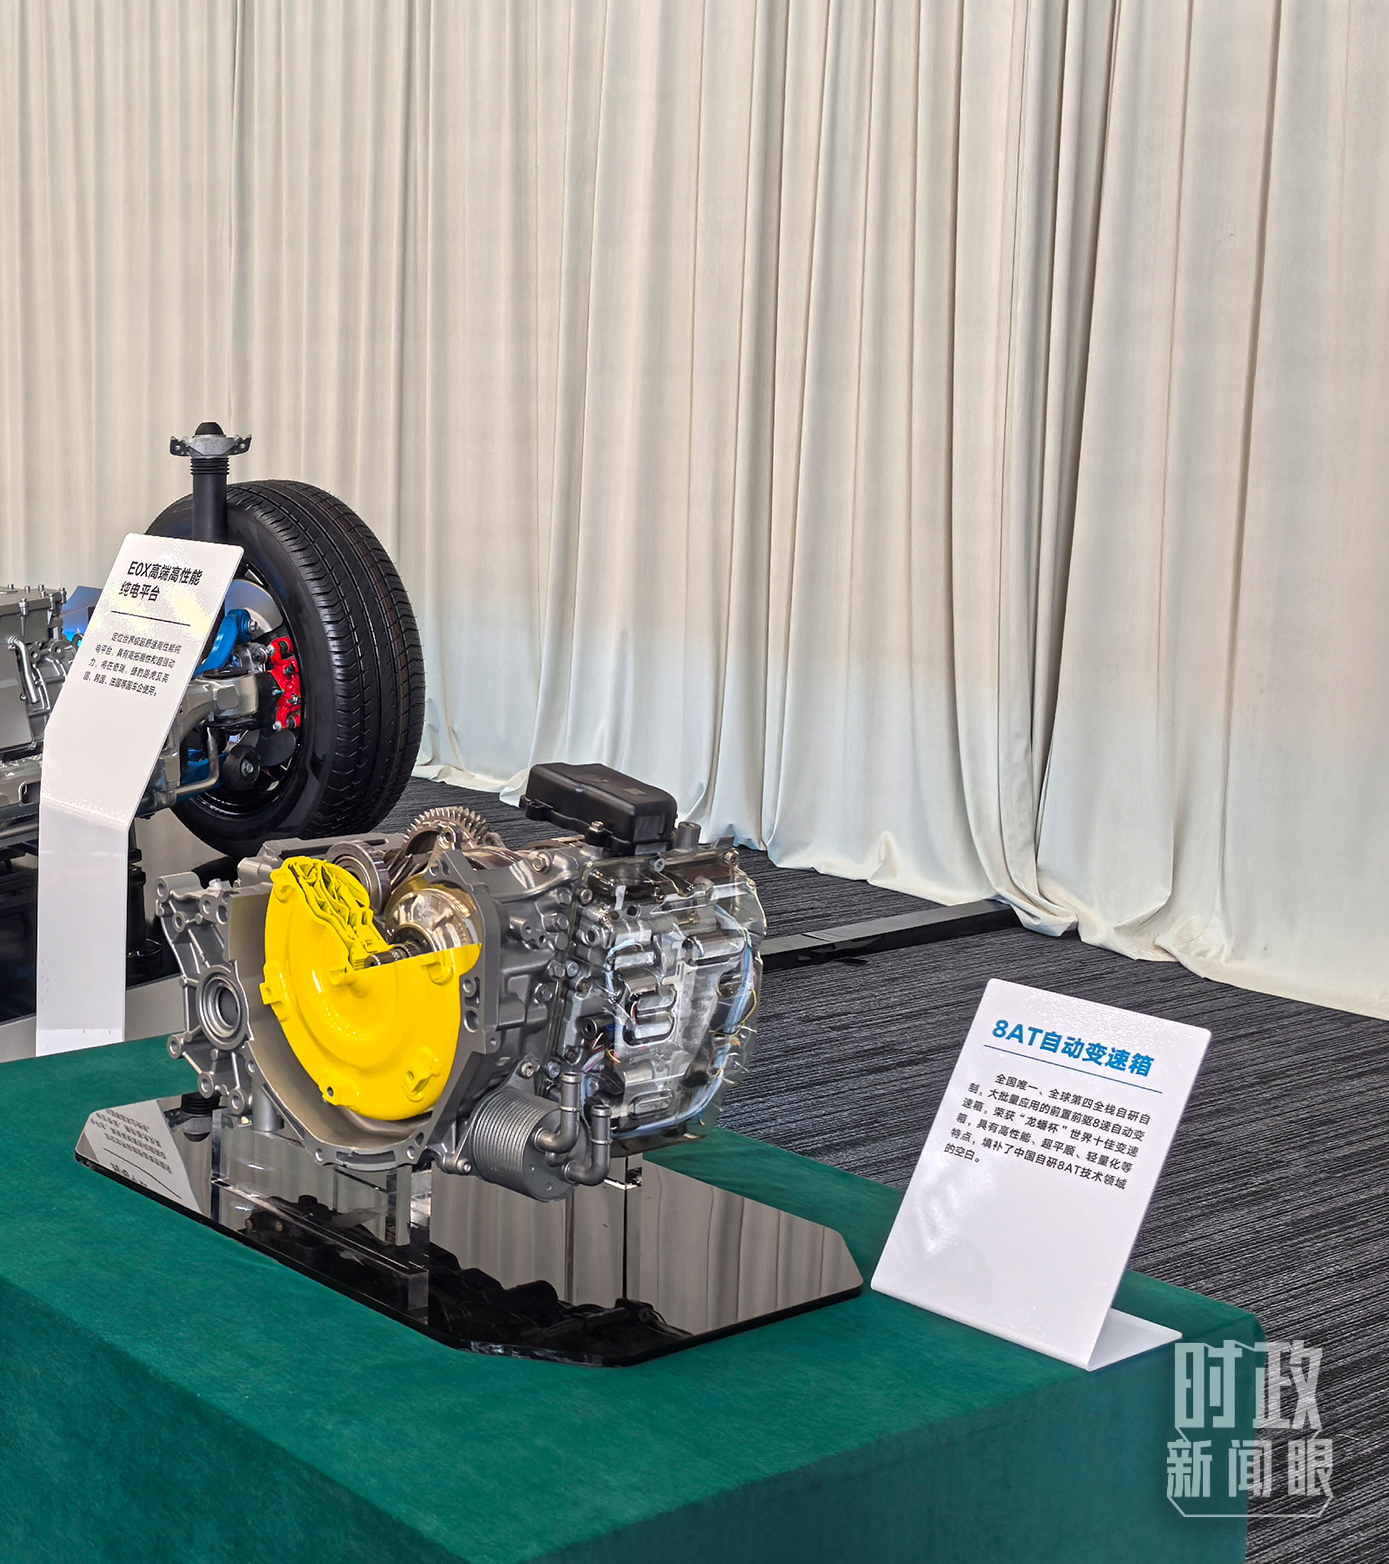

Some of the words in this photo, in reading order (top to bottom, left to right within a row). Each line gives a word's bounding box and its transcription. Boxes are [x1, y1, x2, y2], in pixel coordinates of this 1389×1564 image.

[118, 580, 160, 602] 纯电平台
[992, 1019, 1155, 1078] 8AT自动变速箱
[995, 1073, 1151, 1125] 全国唯一、全球第四全栈自研自
[943, 1142, 980, 1163] 的空白。
